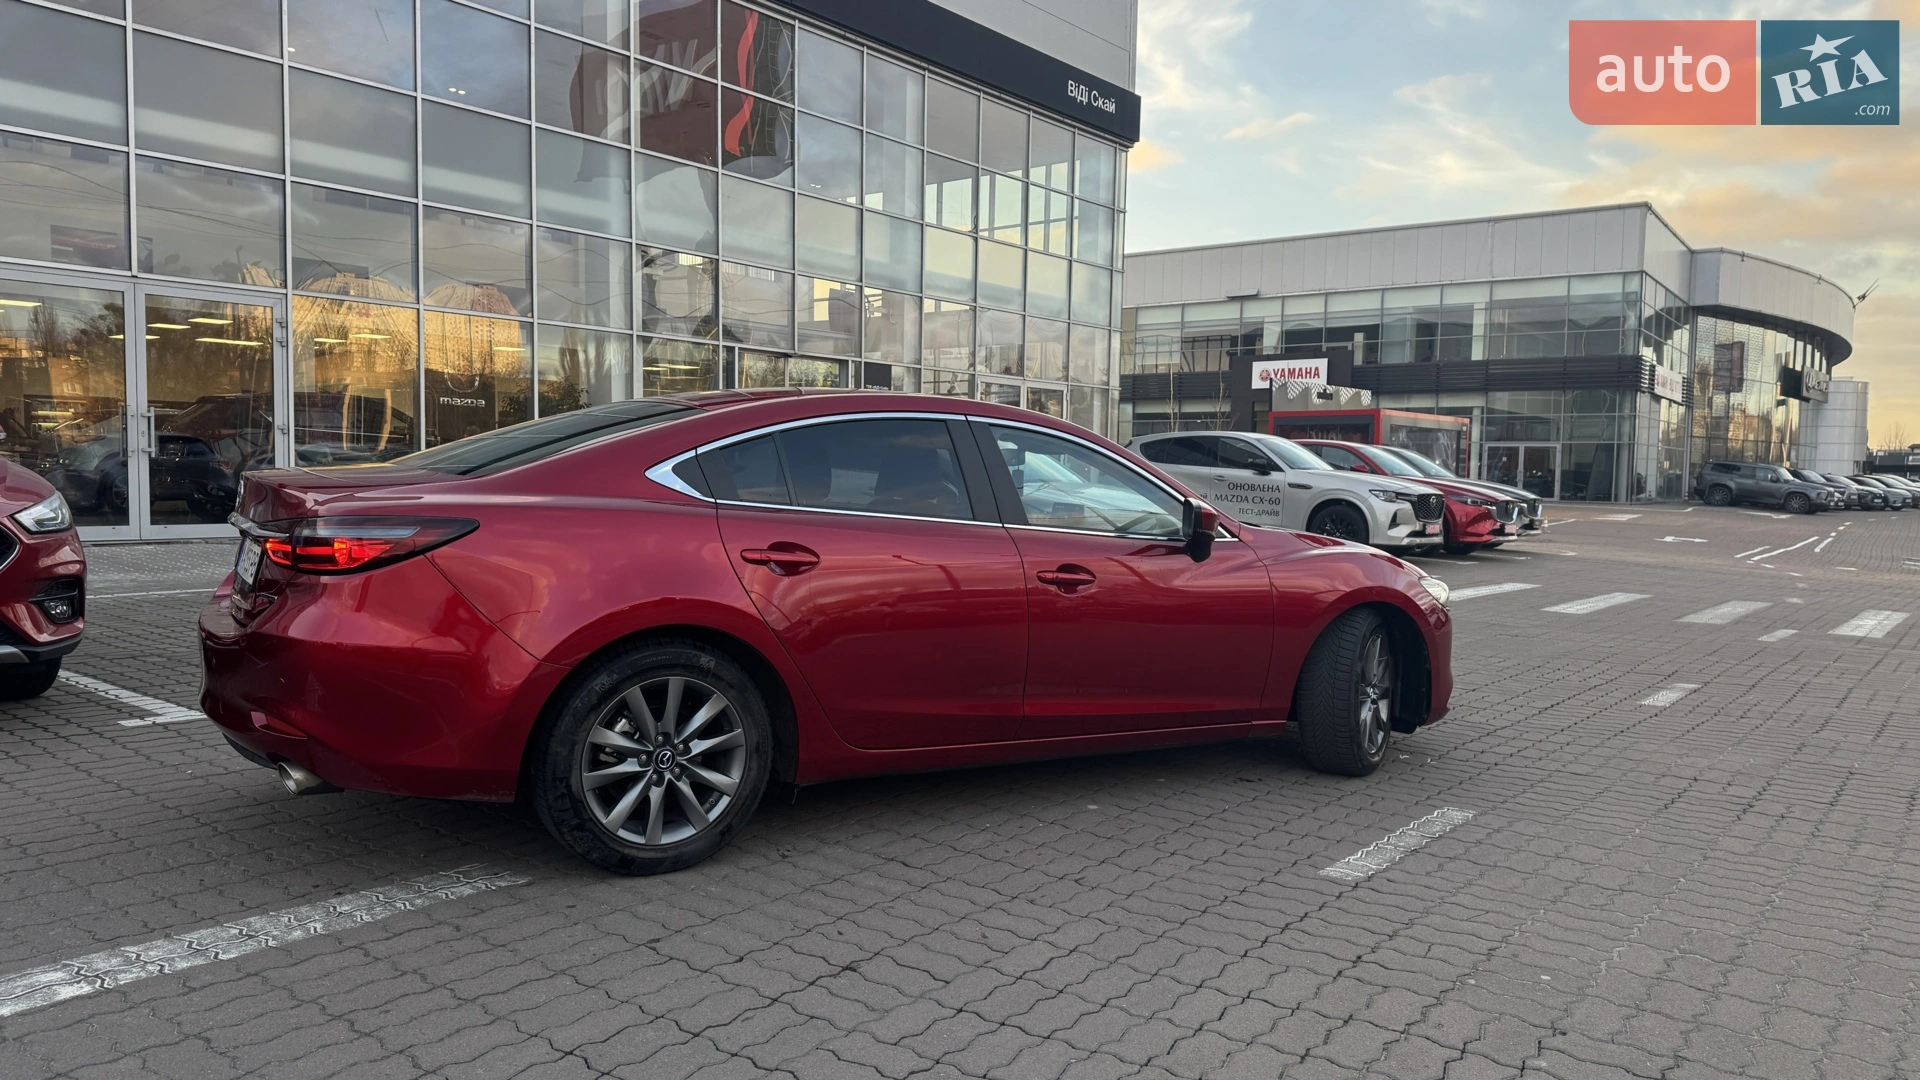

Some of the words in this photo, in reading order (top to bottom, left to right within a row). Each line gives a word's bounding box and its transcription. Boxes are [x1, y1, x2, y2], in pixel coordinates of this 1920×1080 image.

[1067, 79, 1088, 106] ВіДі
[1091, 90, 1116, 114] Скай
[1272, 366, 1321, 380] YAMAHA
[439, 396, 486, 408] mazda
[1227, 481, 1281, 493] ОНОВЛЕНА
[1213, 493, 1250, 504] MAZDA
[1251, 495, 1281, 506] CX-60
[1238, 507, 1280, 517] ТЕСТ-ДРАЙВ
